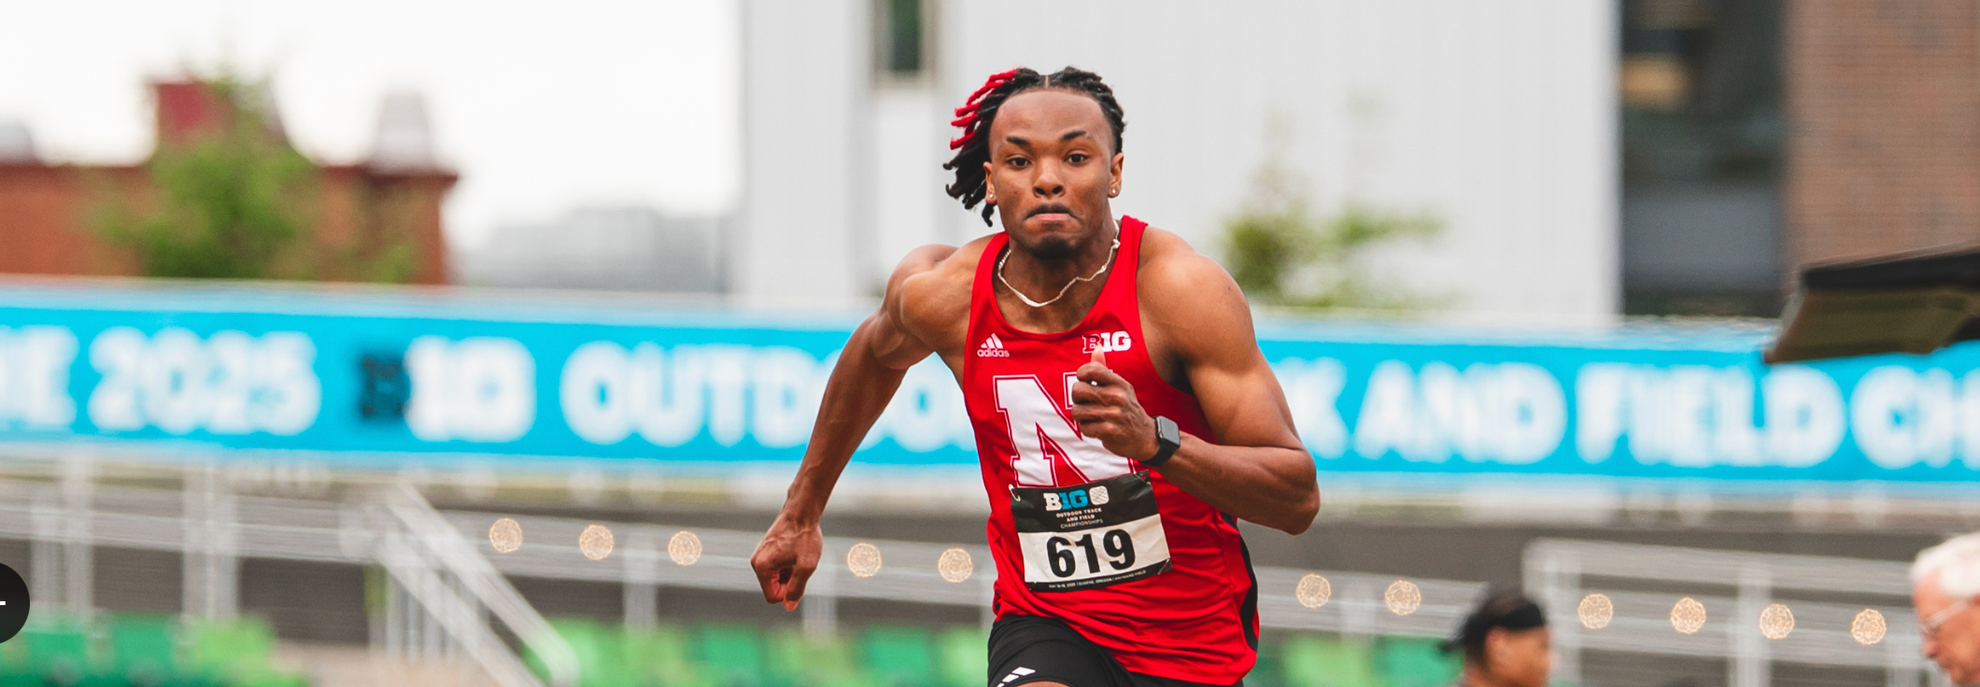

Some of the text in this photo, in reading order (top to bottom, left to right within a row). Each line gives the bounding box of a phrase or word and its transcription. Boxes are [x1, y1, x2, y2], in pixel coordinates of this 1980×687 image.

[977, 348, 1010, 358] adidas
[88, 327, 321, 435] 2025
[1355, 359, 1567, 465] AND
[1575, 362, 1846, 468] FIELD
[993, 372, 1136, 488] N
[1047, 529, 1136, 578] 619
